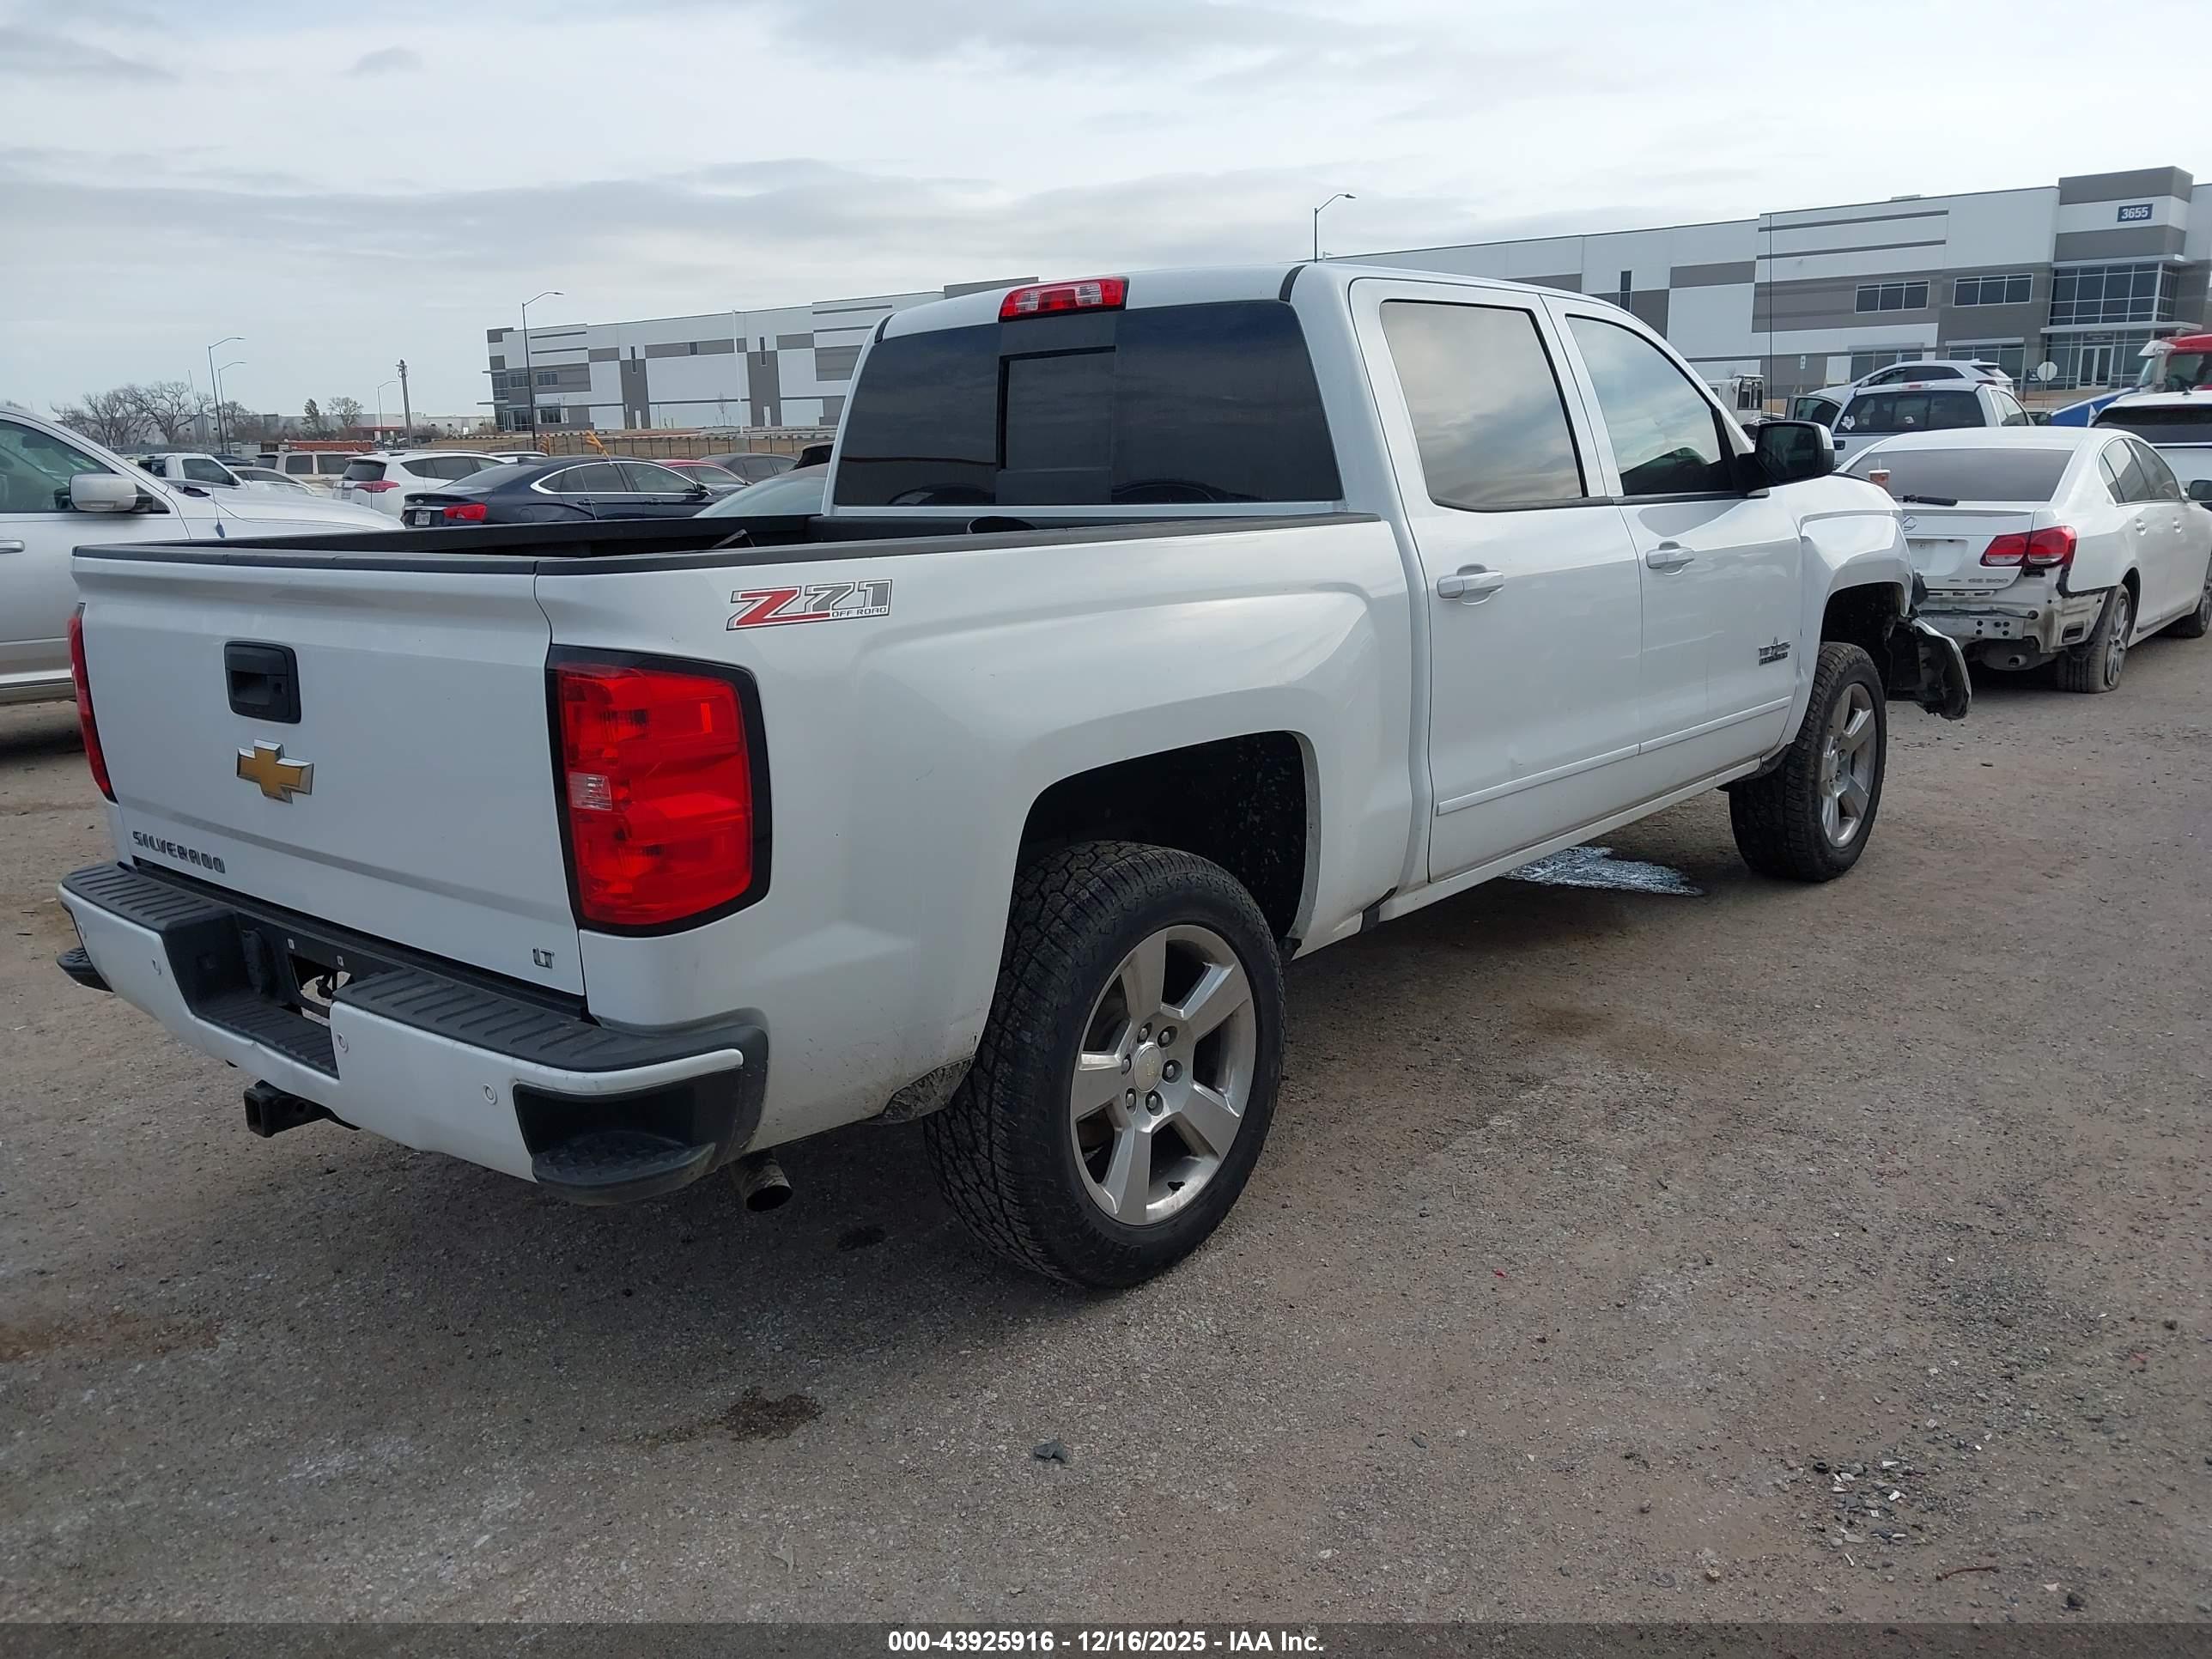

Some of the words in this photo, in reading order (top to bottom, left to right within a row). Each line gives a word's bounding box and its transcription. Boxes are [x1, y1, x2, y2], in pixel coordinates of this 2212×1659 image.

[2121, 206, 2148, 219] 3655
[726, 579, 893, 631] Z71
[831, 609, 854, 618] OFF
[856, 606, 887, 616] ROAD
[132, 830, 226, 874] SILVERADO
[532, 947, 555, 969] LT
